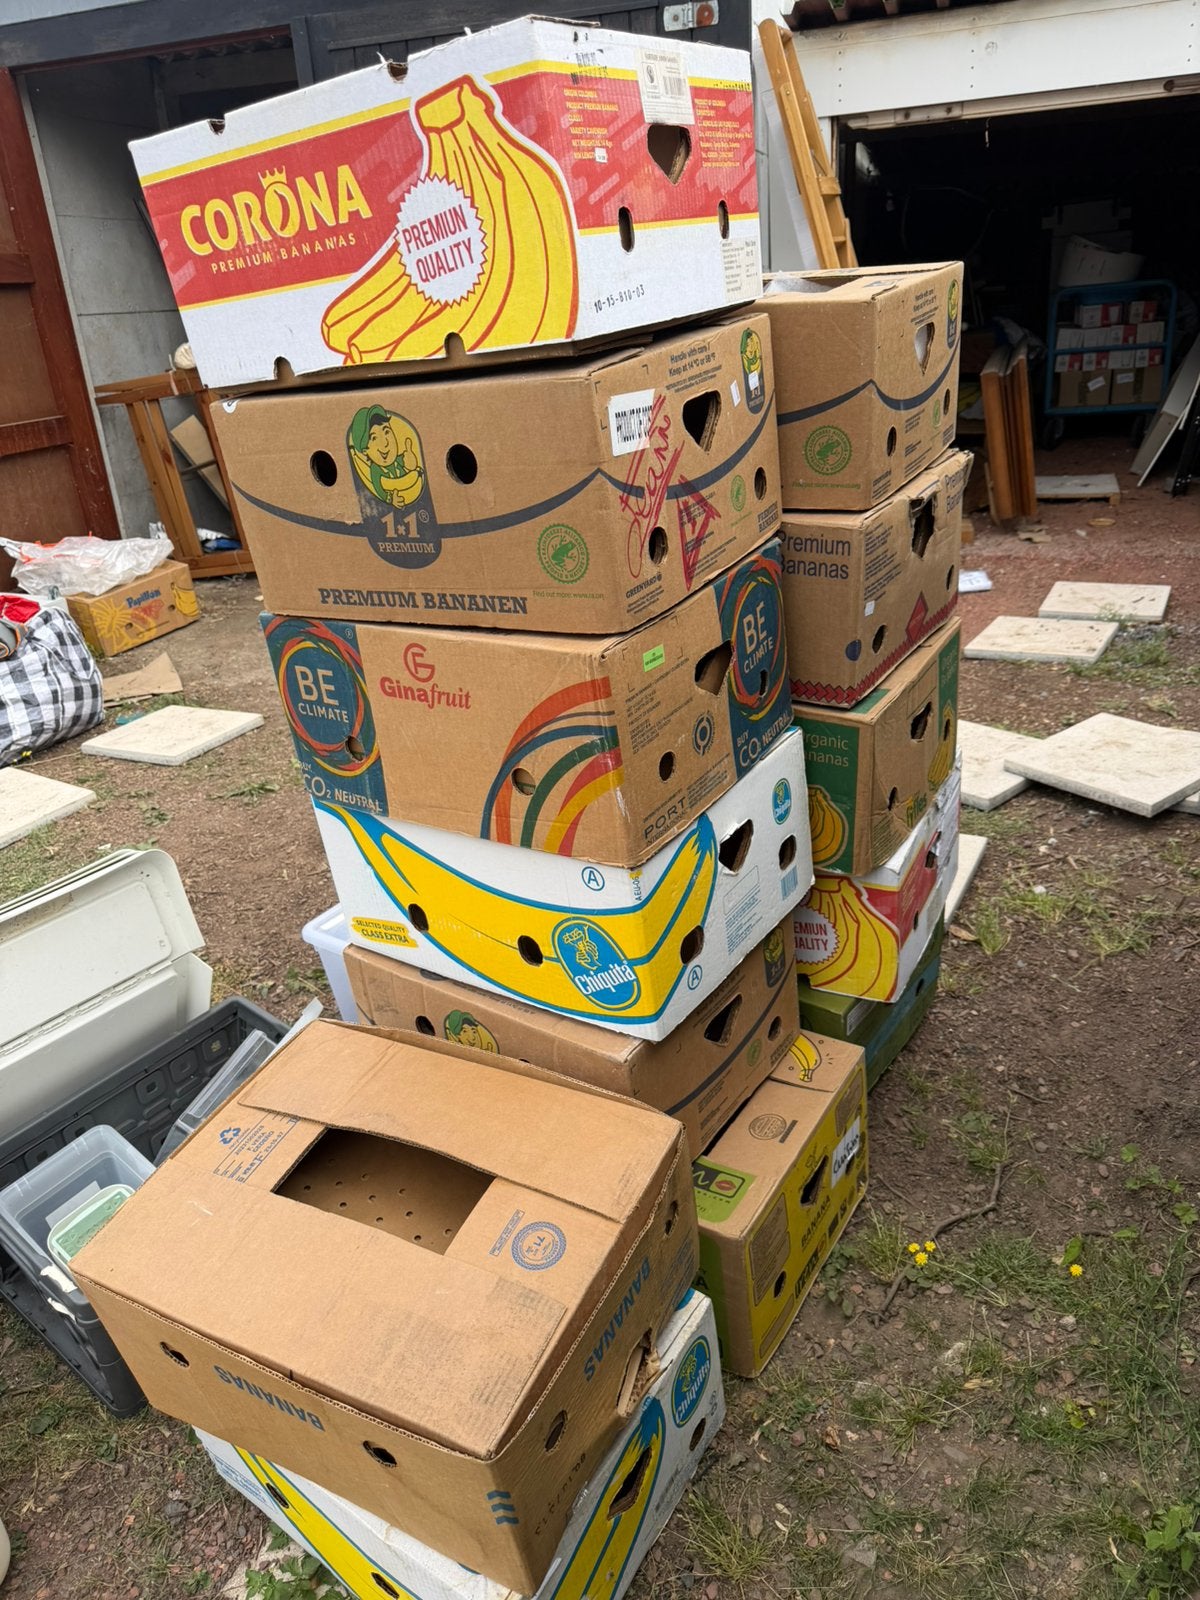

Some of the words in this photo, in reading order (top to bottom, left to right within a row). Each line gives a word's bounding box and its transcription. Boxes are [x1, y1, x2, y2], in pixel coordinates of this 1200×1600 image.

[180, 164, 372, 256] CORONA
[401, 203, 469, 254] PREMIUN
[211, 250, 273, 274] PREMIUM
[281, 232, 356, 260] BANANAS
[415, 237, 474, 283] QUALITY
[378, 541, 436, 555] PREMIUM
[318, 587, 419, 610] PREMIUM
[421, 591, 529, 615] BANANEN
[742, 601, 767, 654] BE
[743, 636, 774, 674] CLIMATE
[294, 665, 340, 706] BE
[379, 676, 472, 710] Ginafruit
[297, 703, 350, 723] CLIMATE
[762, 710, 791, 747] NEUTRAL
[736, 729, 749, 748] BUY
[803, 733, 849, 750] rganic
[334, 788, 383, 815] NEUTRAL
[644, 796, 687, 839] PORT
[355, 919, 383, 931] SELECTED
[383, 922, 405, 934] QUALITY
[361, 928, 384, 943] CLASS
[384, 930, 409, 944] EXTRA
[574, 962, 638, 997] Chiquita
[584, 1256, 652, 1384] BANANAS
[213, 1364, 326, 1433] BANANAS
[676, 1359, 711, 1425] Chiquita
